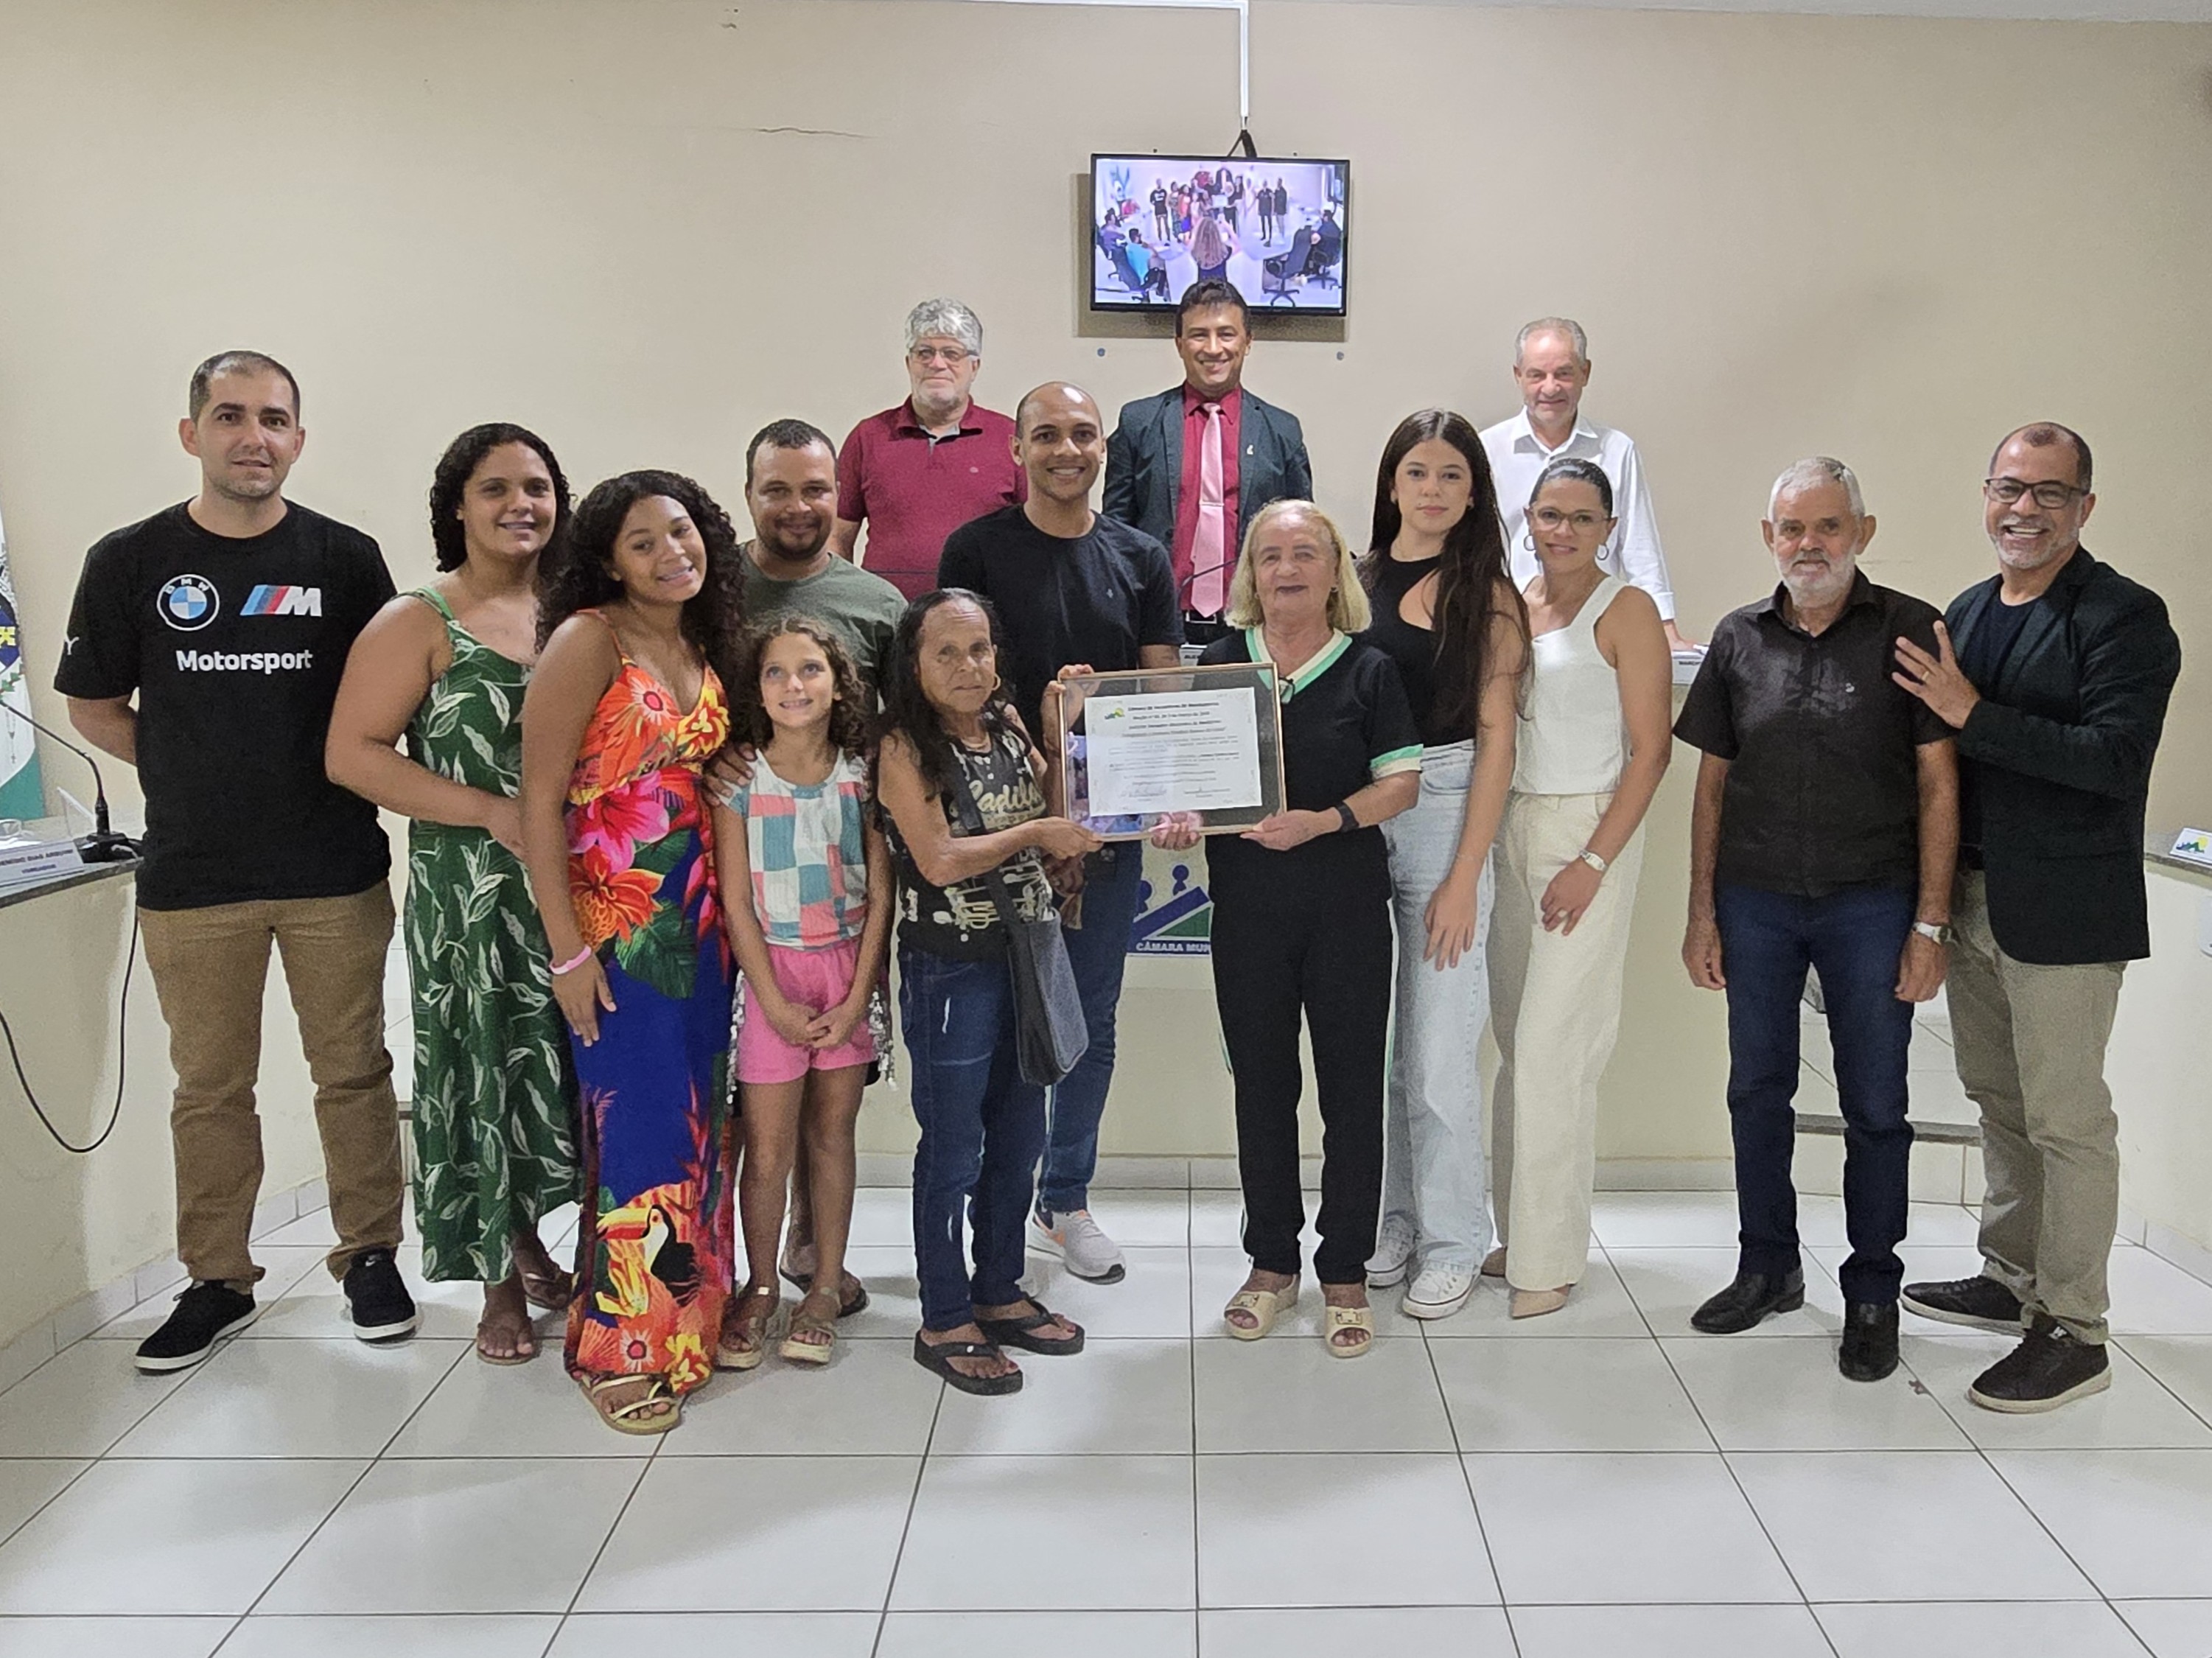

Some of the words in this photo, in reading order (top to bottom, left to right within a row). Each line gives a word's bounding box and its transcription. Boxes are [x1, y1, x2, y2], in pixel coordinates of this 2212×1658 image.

[164, 578, 210, 595] BMW
[275, 586, 323, 617] M
[176, 650, 313, 674] Motorsport
[1135, 941, 1183, 952] CÂMARA
